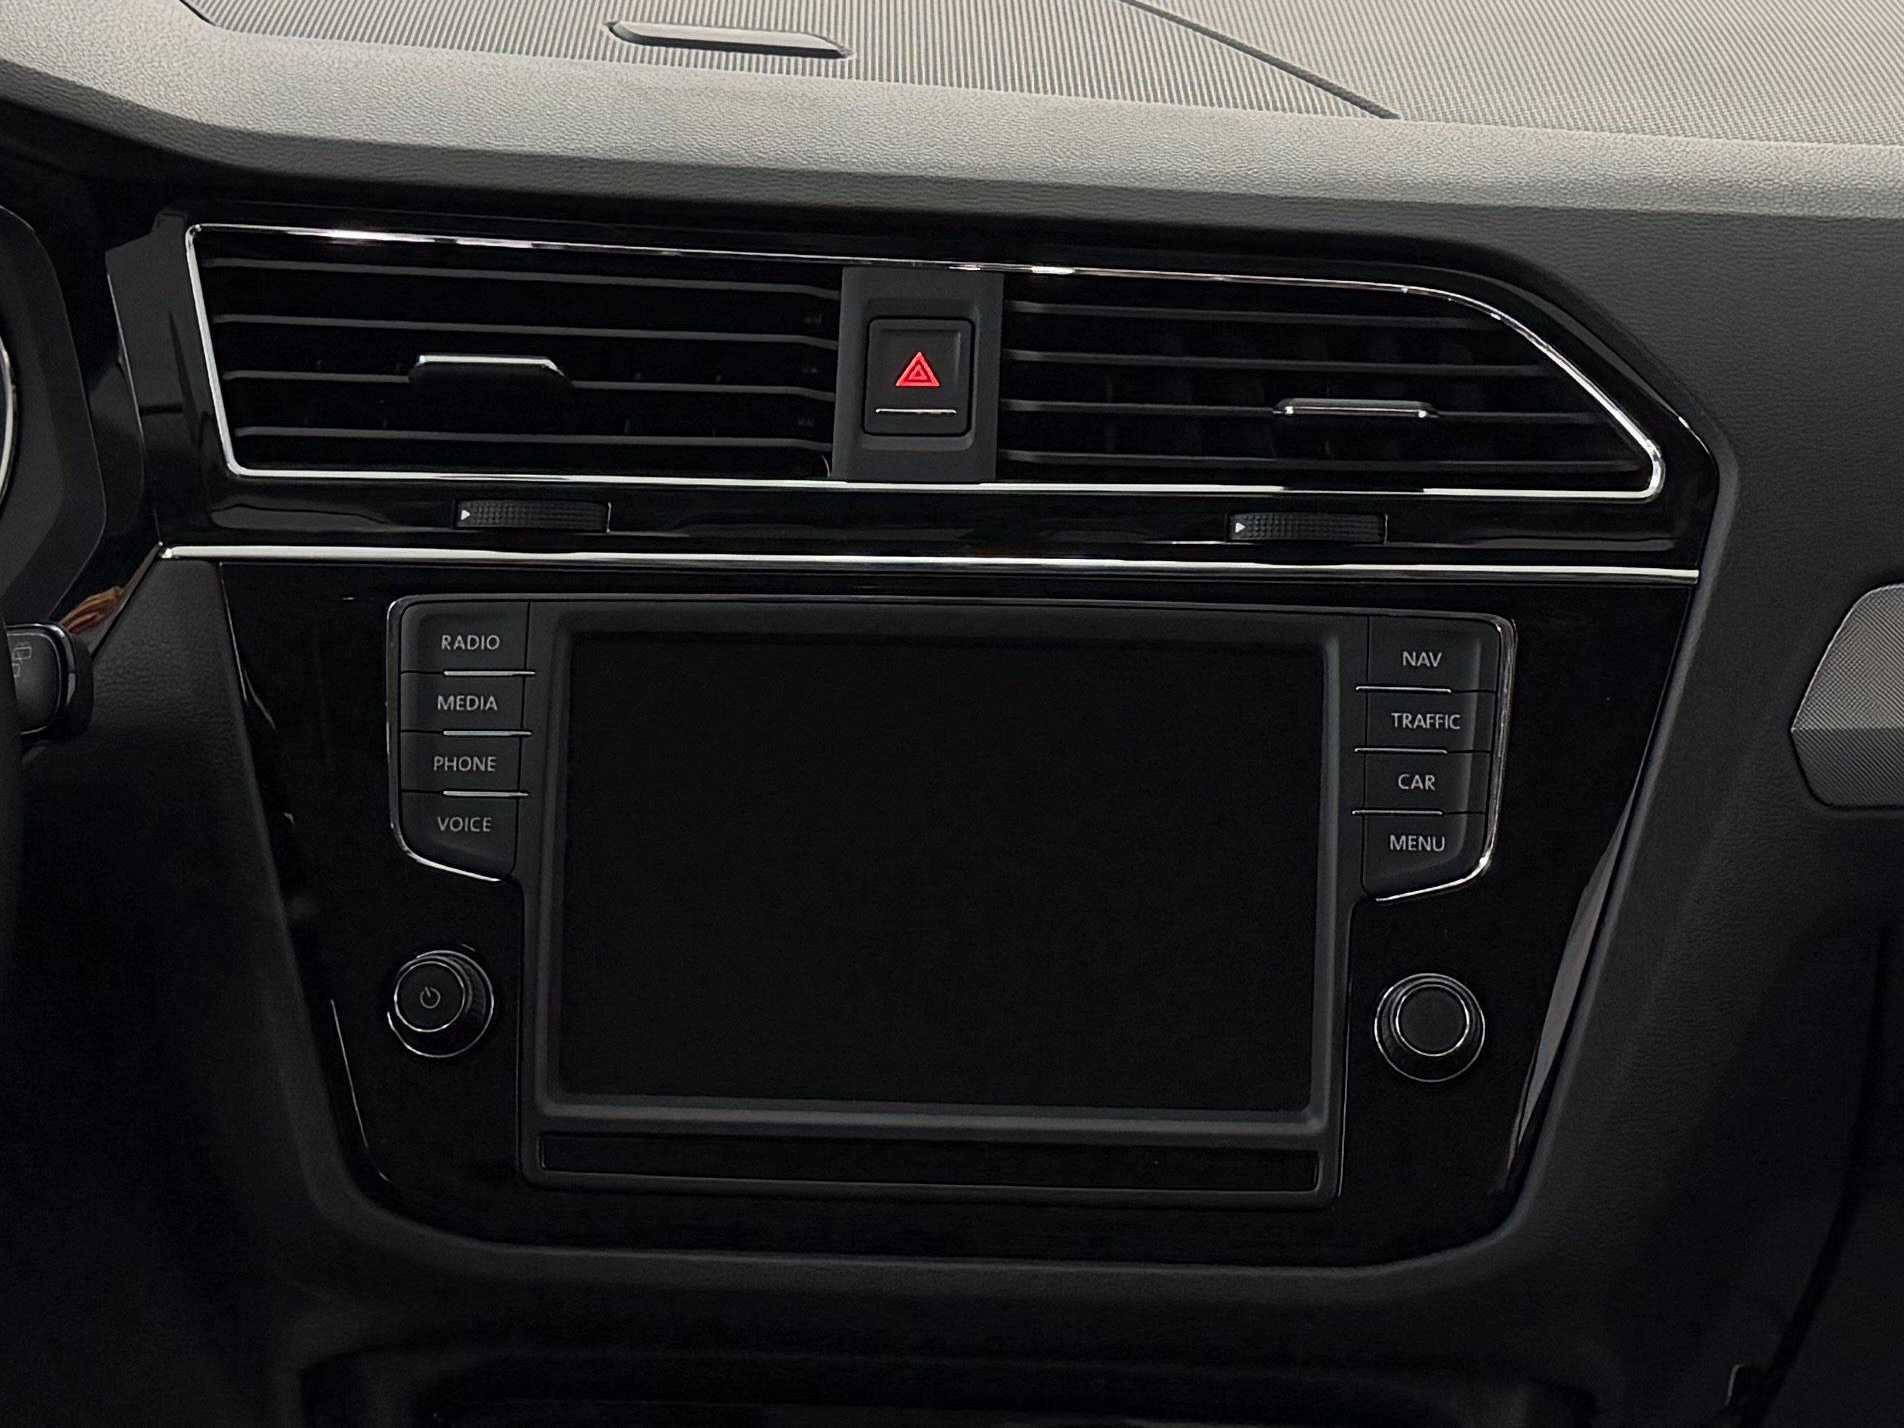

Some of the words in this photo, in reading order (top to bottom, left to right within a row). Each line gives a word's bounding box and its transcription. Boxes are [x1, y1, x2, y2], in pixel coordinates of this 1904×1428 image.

[441, 635, 500, 651] RADIO
[1402, 651, 1442, 667] NAV
[437, 695, 498, 711] MEDIA
[1391, 712, 1461, 730] TRAFFIC
[433, 756, 496, 772] PHONE
[1397, 774, 1436, 791] CAR
[437, 816, 491, 832] VOICE
[1389, 834, 1446, 852] MENU
